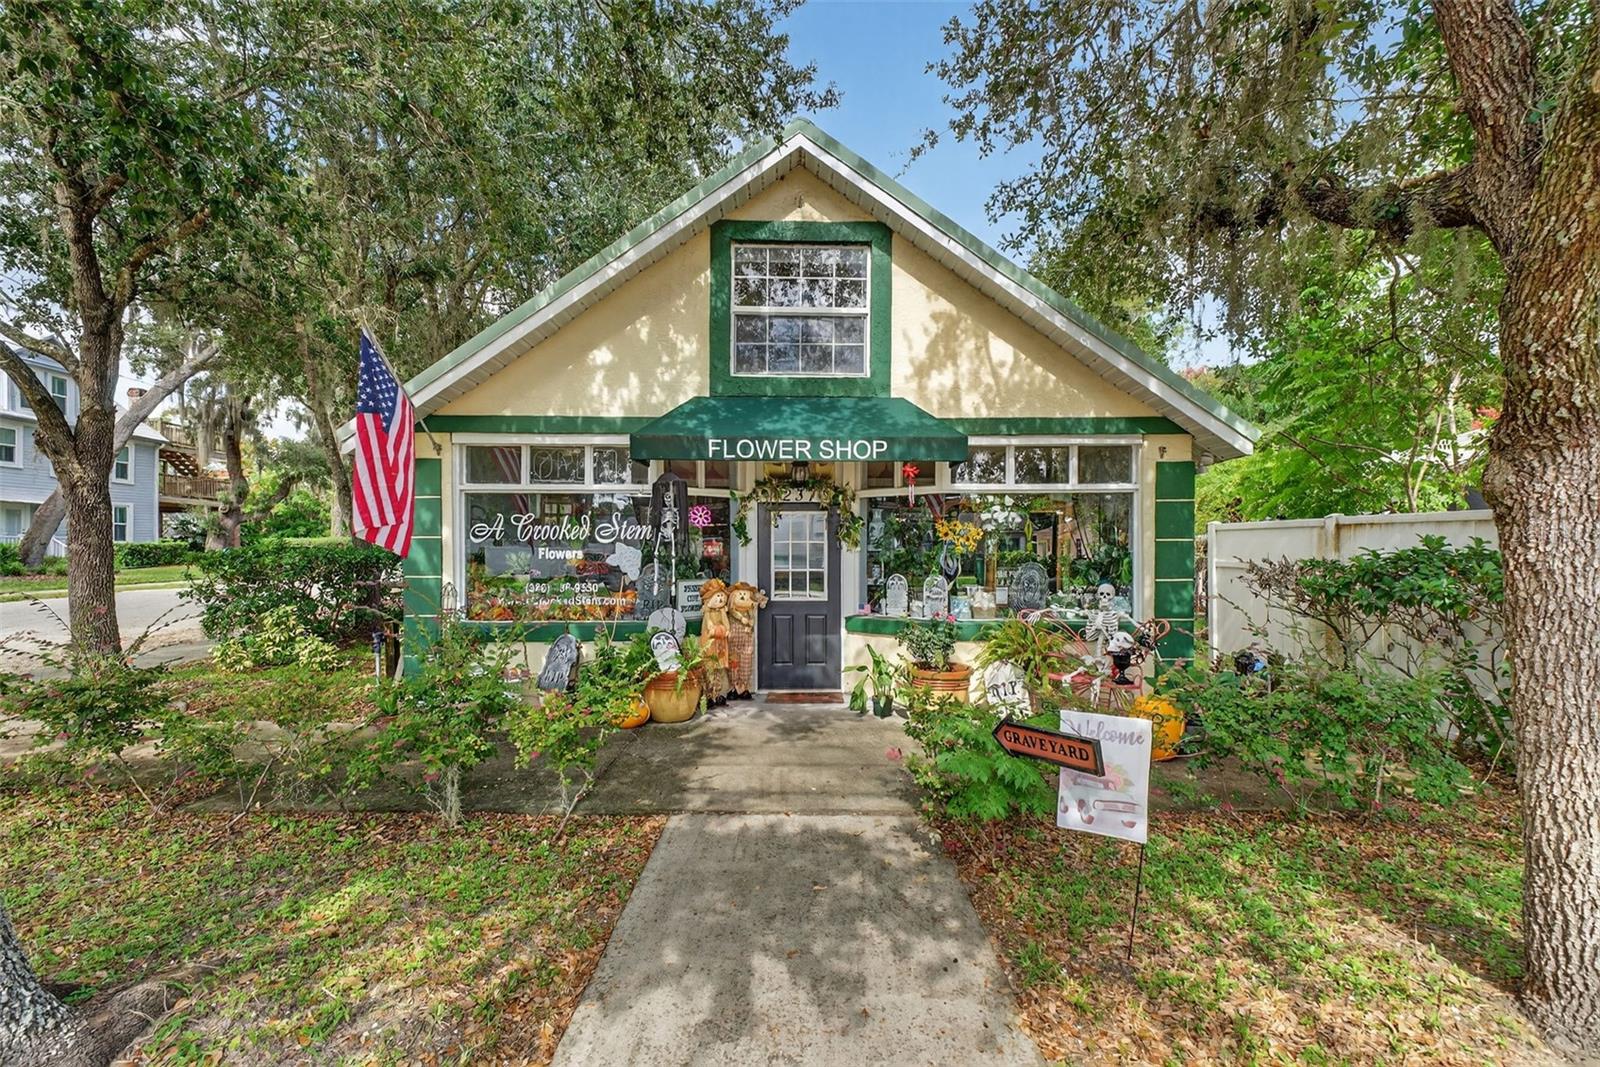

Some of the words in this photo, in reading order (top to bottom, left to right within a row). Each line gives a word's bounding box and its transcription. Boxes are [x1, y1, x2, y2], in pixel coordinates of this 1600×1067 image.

[708, 439, 812, 459] FLOWER
[819, 440, 888, 459] SHOP
[469, 513, 504, 543] A
[510, 511, 591, 542] Crooked
[594, 511, 652, 543] Stem
[538, 547, 584, 560] Flowers
[1003, 730, 1090, 761] GRAVEYARD
